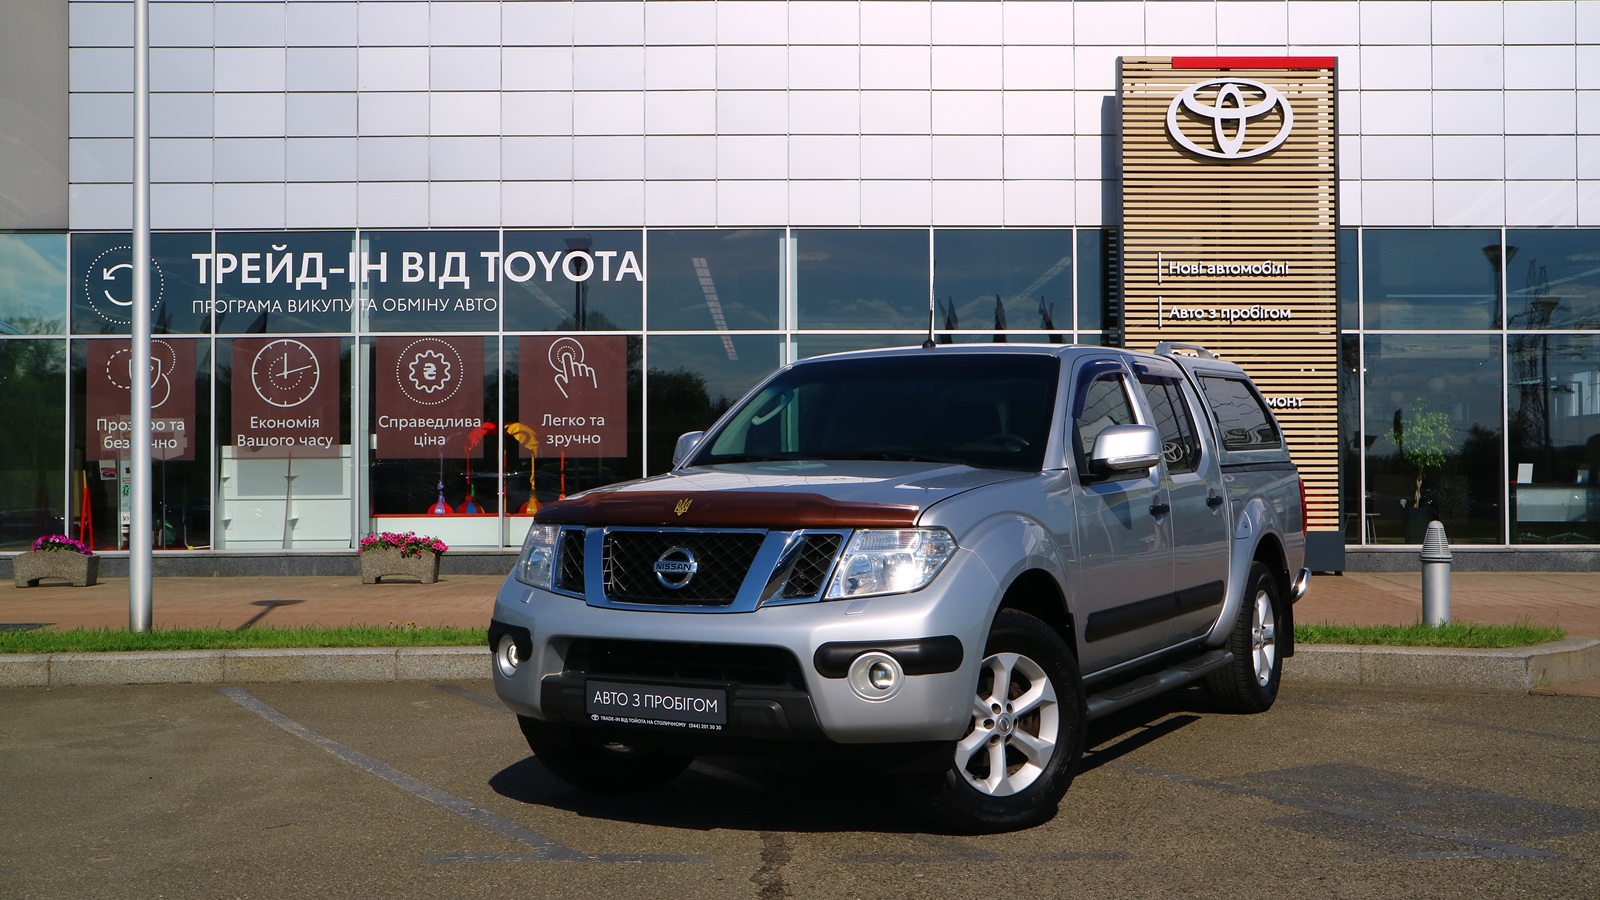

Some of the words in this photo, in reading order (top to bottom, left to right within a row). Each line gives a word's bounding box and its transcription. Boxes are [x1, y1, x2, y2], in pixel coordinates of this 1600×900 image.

[191, 244, 388, 291] ТРЕЙД-ІН
[402, 251, 470, 290] ВІД
[480, 250, 643, 283] TOYOTA
[1168, 261, 1203, 275] Нові
[1207, 260, 1289, 275] автомобілі
[192, 299, 283, 314] ПРОГРАМА
[288, 298, 355, 313] ВИКУПУ
[358, 298, 378, 312] ТА
[382, 298, 450, 313] ОБМІНУ
[453, 298, 497, 312] АВТО
[1168, 305, 1205, 319] Авто
[1208, 308, 1217, 319] з
[1220, 305, 1292, 322] пробігом
[1264, 397, 1304, 408] монт
[97, 418, 165, 434] Прозо
[169, 420, 185, 431] та
[250, 415, 320, 429] Економія
[378, 415, 481, 431] Справедлива
[541, 413, 586, 427] Легко
[589, 416, 605, 426] та
[103, 435, 178, 449] безчно
[237, 434, 295, 447] Вашого
[299, 436, 333, 449] часу
[414, 432, 446, 448] ціна
[546, 434, 601, 448] зручно
[656, 563, 692, 571] NISSAN
[593, 690, 629, 706] АВТО
[644, 694, 718, 713] ПРОБІГОМ
[629, 717, 646, 725] ТОЙОТА
[653, 719, 687, 728] СТОЛИЧНОМУ
